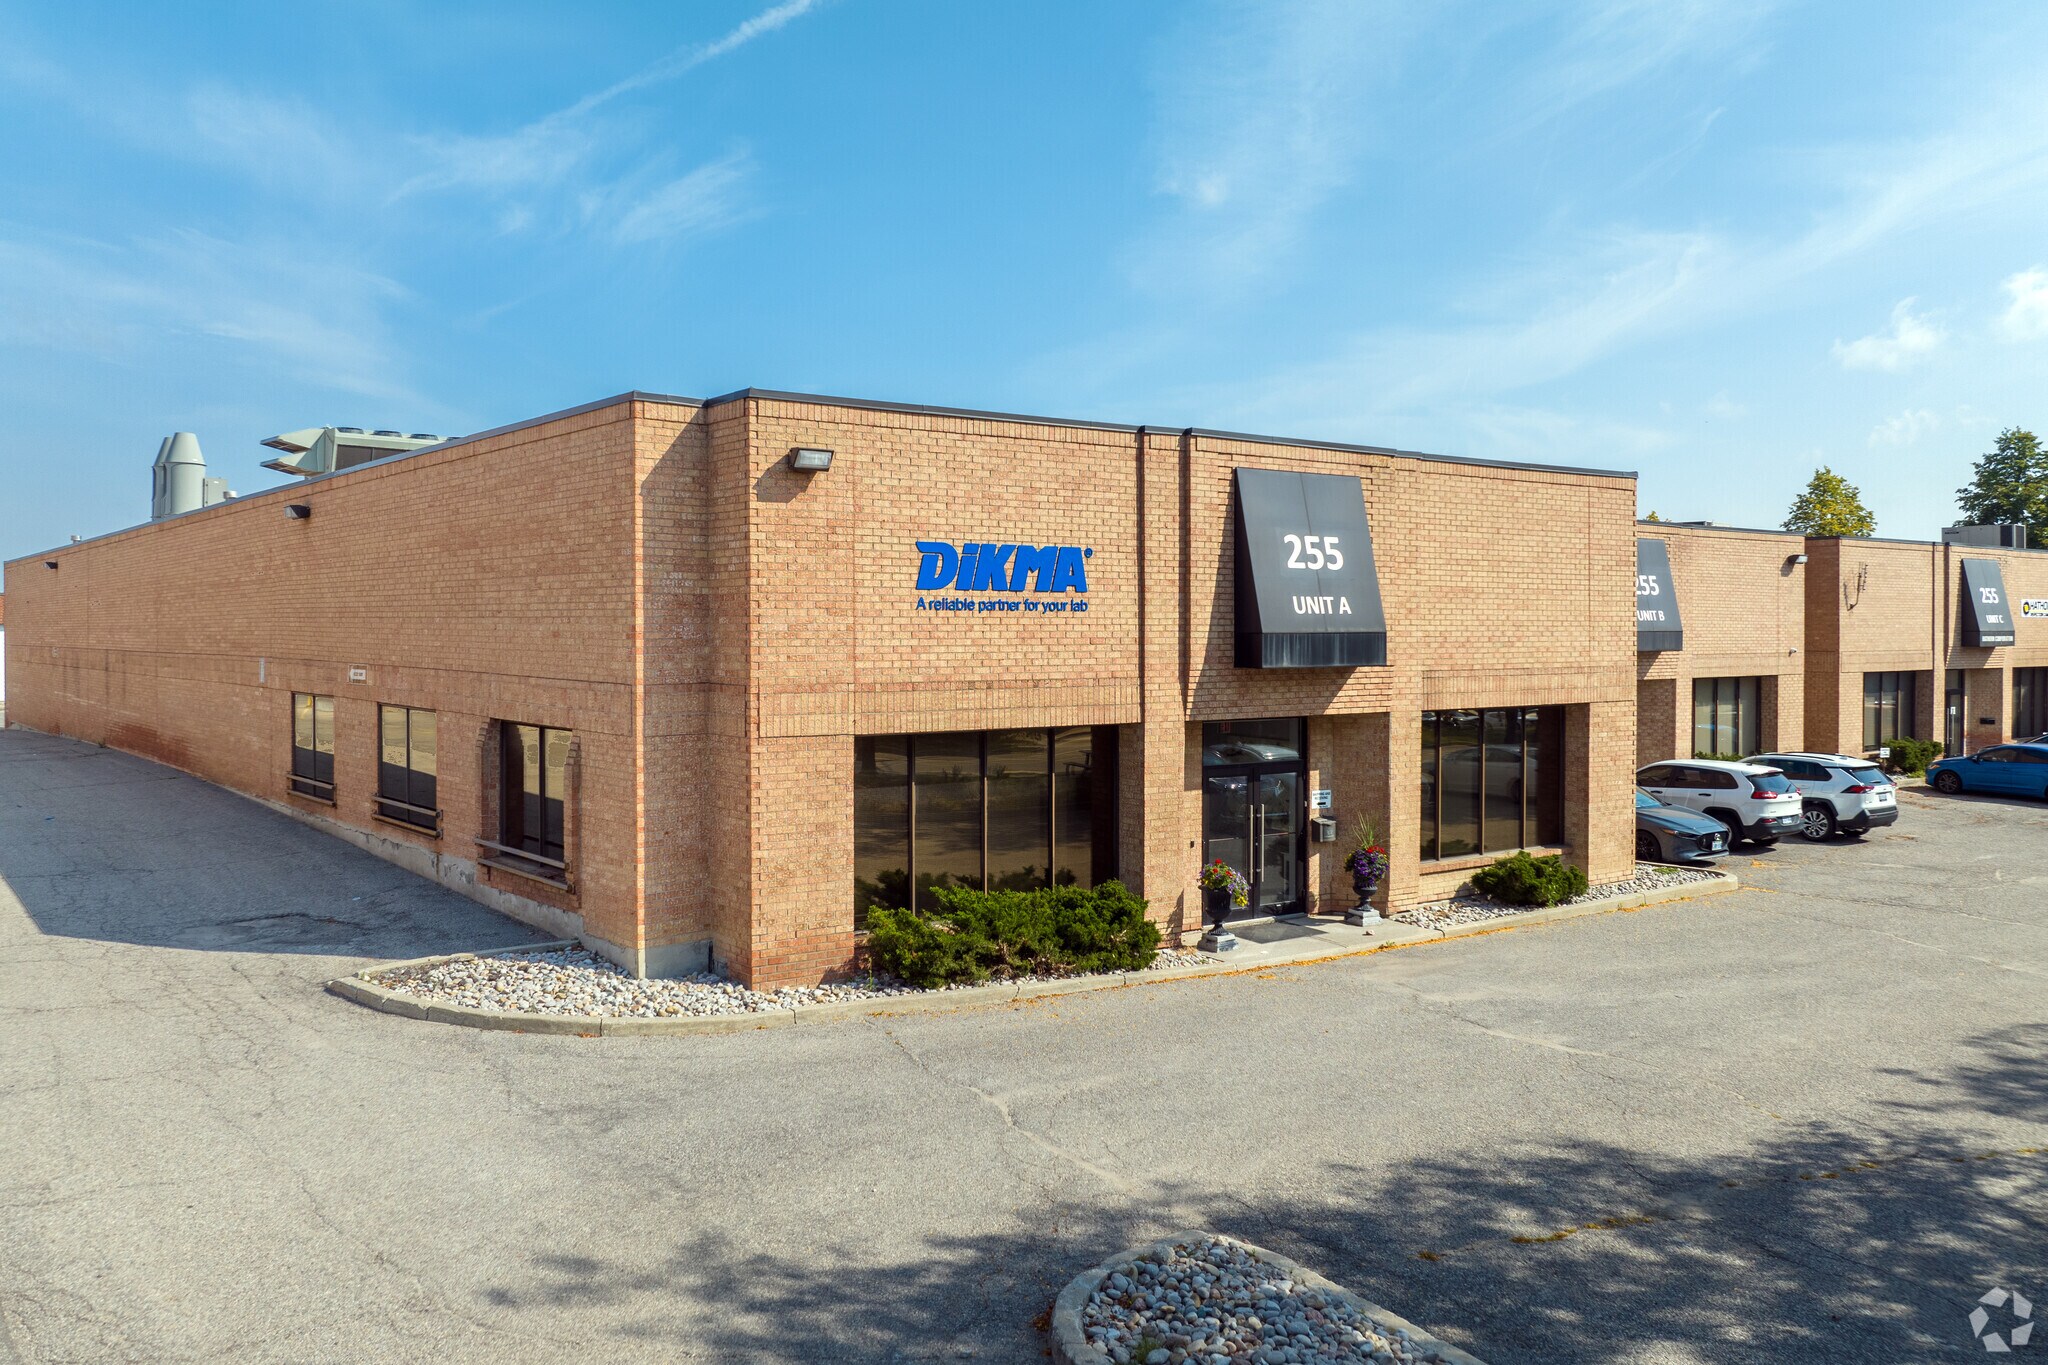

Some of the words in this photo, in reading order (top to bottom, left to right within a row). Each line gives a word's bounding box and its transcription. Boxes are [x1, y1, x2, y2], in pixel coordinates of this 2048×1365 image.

[1284, 534, 1344, 571] 255
[1979, 587, 1999, 603] 255
[916, 597, 926, 610] A
[929, 598, 975, 611] reliable
[978, 599, 1022, 613] partner
[1024, 599, 1041, 612] for
[1042, 601, 1068, 614] your
[1070, 600, 1088, 612] lab
[1293, 596, 1334, 614] UNIT
[1339, 597, 1352, 614] A
[1637, 610, 1657, 621] UNIT
[1659, 611, 1665, 621] B
